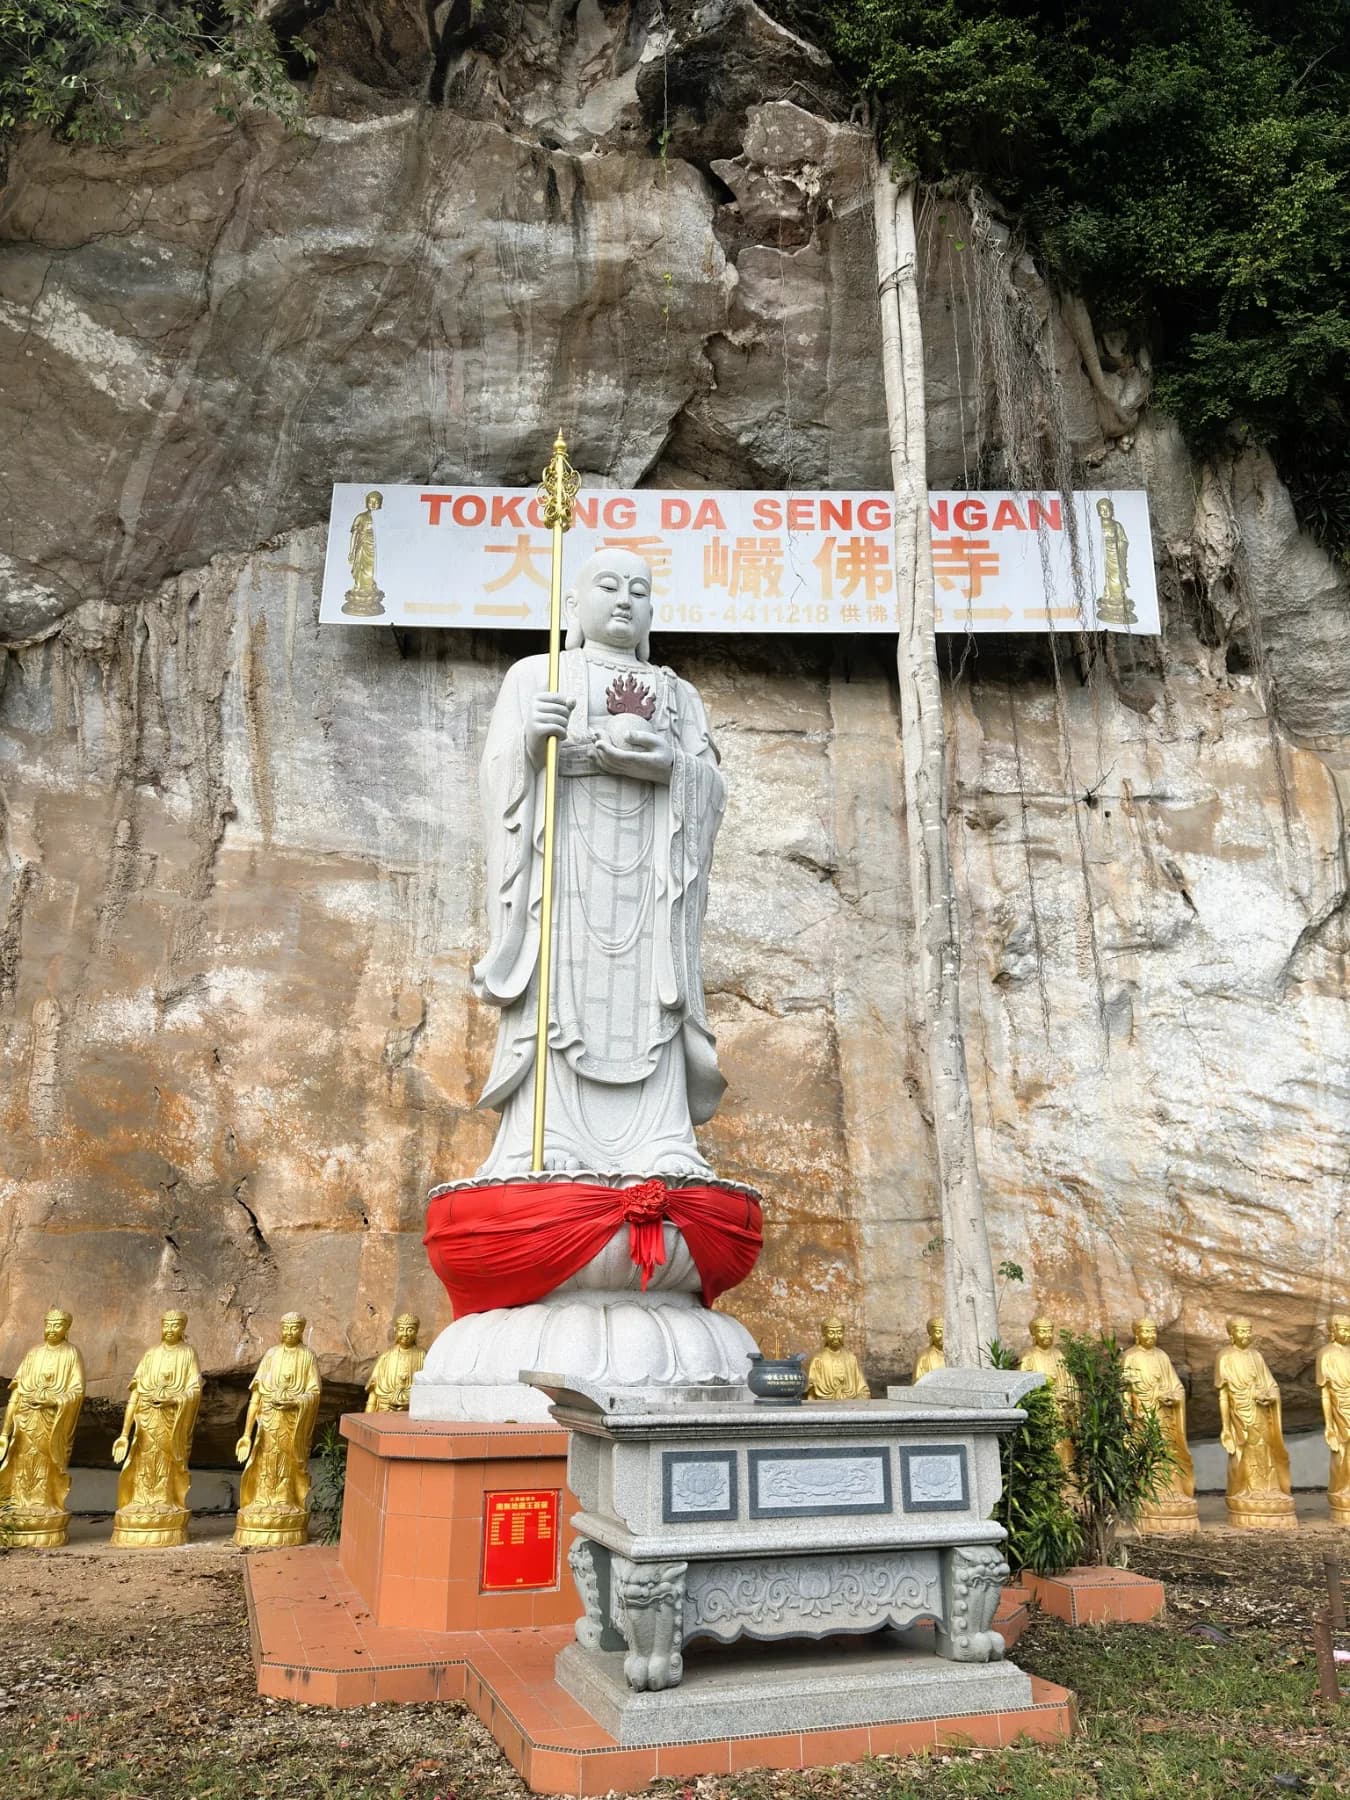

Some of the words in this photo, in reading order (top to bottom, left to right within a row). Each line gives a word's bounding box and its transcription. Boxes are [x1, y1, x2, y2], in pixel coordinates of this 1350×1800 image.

[660, 498, 727, 530] DA
[753, 499, 892, 531] SENG
[659, 603, 830, 625] 016-4411218
